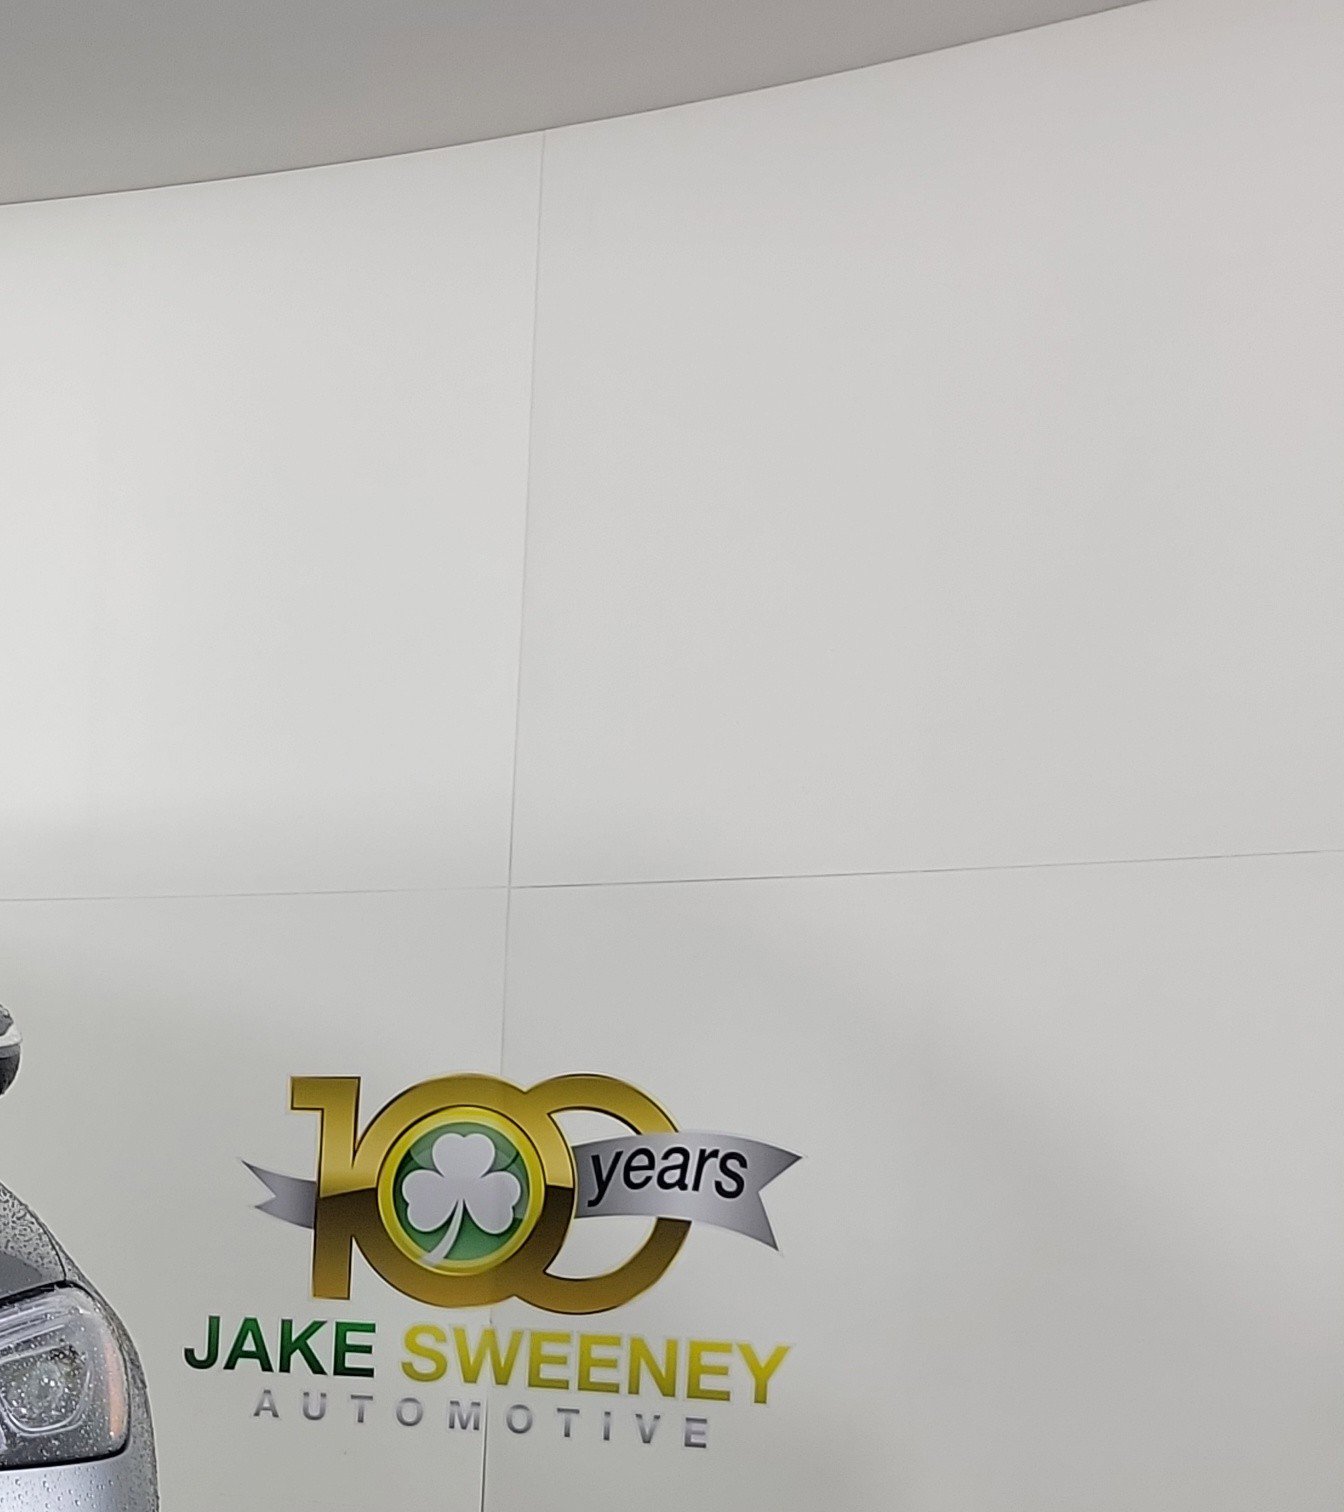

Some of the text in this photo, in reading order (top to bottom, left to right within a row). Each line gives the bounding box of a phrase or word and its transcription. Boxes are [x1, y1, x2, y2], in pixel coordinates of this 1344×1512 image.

[290, 1073, 748, 1315] 100 years
[184, 1316, 792, 1404] JAKE SWEENEY
[253, 1389, 708, 1448] AUTOMOTIVE
